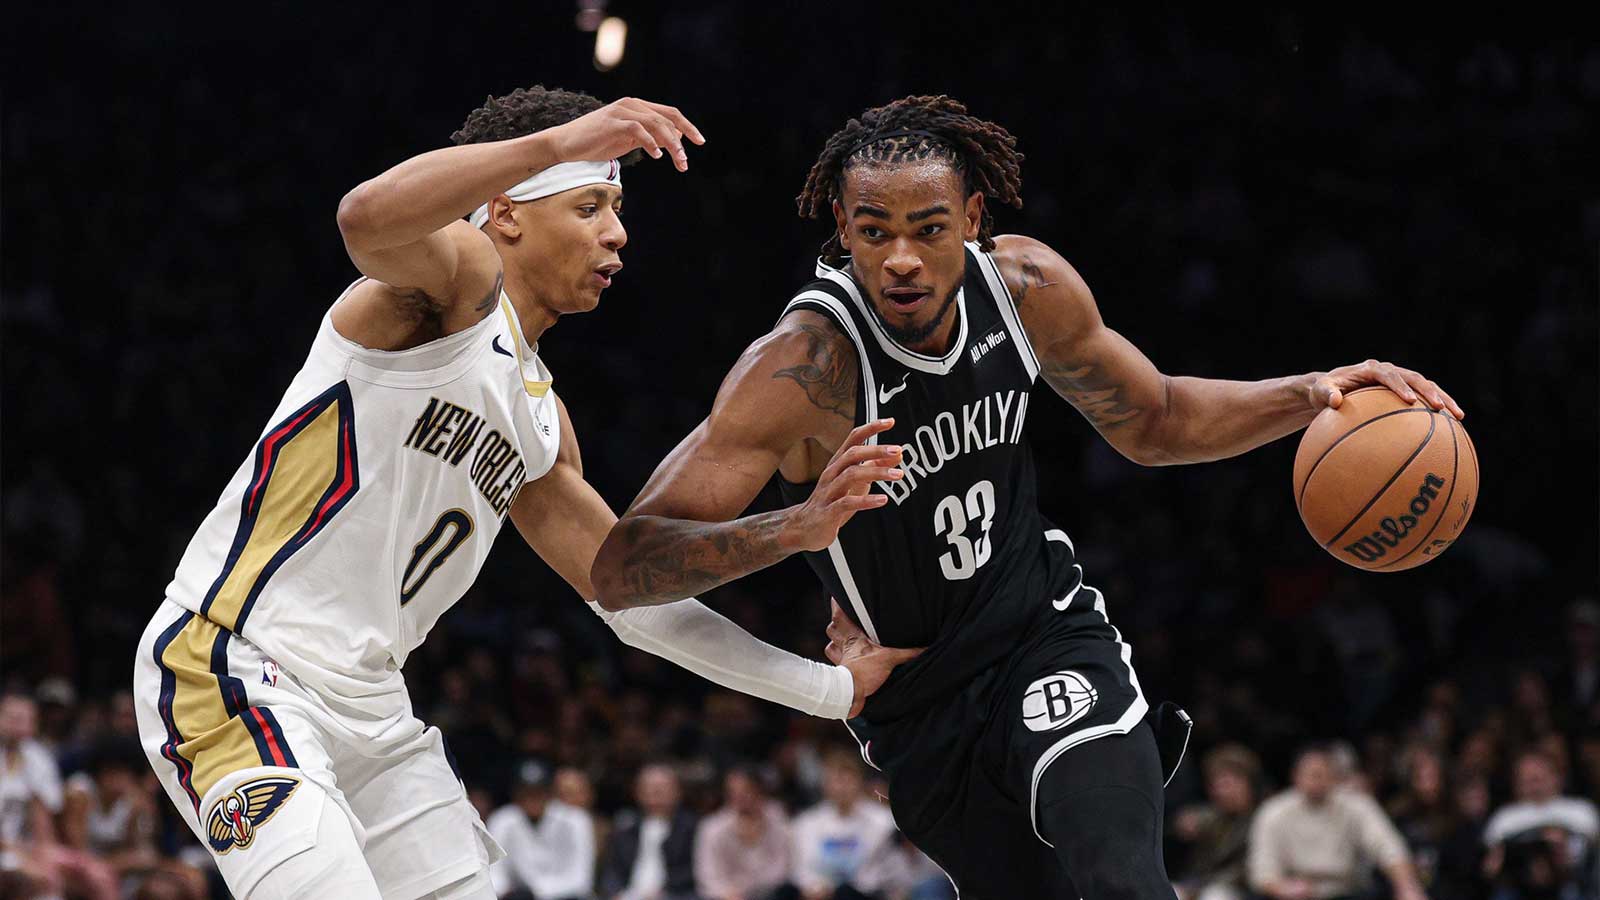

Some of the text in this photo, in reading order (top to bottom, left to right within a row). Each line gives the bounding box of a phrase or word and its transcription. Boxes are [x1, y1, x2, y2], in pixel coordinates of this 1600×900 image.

[970, 330, 1007, 364] All In Won
[403, 396, 486, 467] NEW
[934, 479, 996, 581] 33
[1344, 472, 1446, 562] Wilson
[400, 507, 475, 608] 0
[1043, 679, 1073, 723] B
